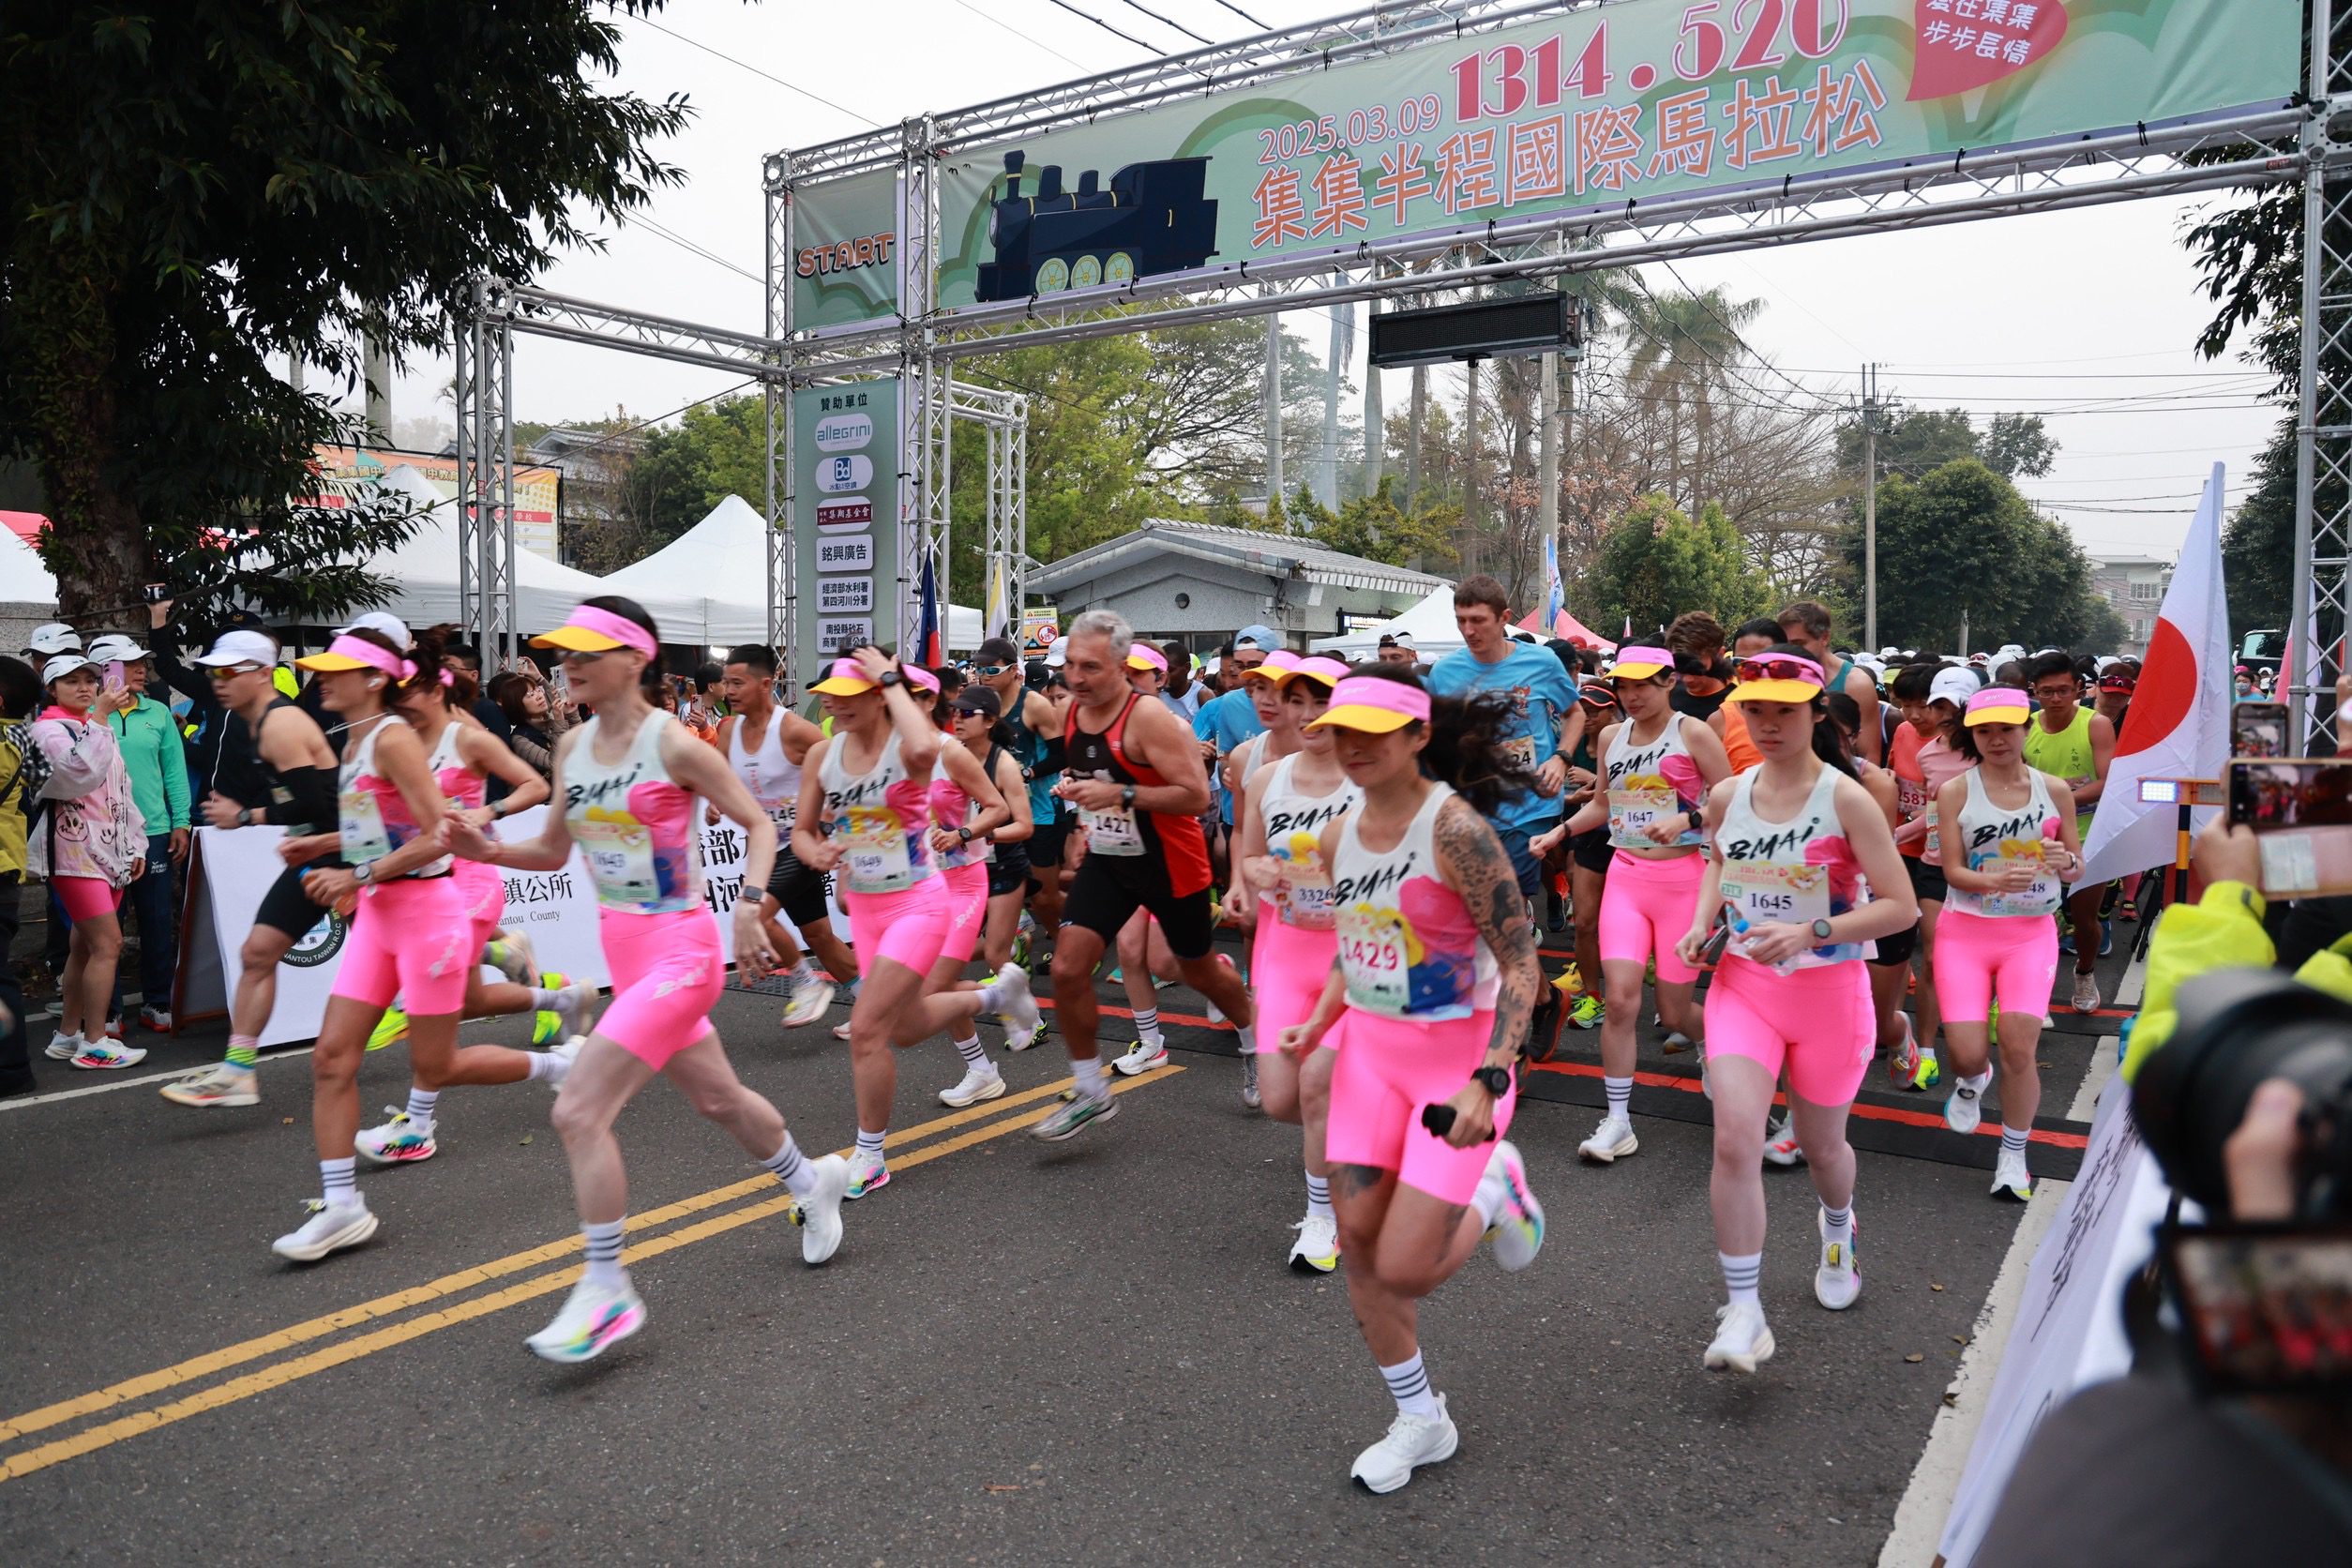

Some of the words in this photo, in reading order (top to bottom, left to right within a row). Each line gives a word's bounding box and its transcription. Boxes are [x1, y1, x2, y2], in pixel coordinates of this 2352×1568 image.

[1922, 20, 2031, 66] 步步長情
[1258, 95, 1442, 165] 2025.03.09
[1250, 58, 1888, 249] 集集半程國際馬拉松
[795, 232, 897, 279] START
[821, 393, 868, 412] 贊助單位
[822, 544, 867, 562] 銘興廣告
[822, 581, 868, 594] 經濟部水利署
[822, 596, 868, 607] 第四河川分署
[826, 624, 864, 634] 南投縣砂石
[1095, 816, 1131, 834] 1427
[1628, 811, 1653, 822] 1647
[1751, 893, 1792, 910] 1645
[498, 915, 524, 926] antou
[530, 911, 561, 921] County
[313, 942, 337, 961] TAIWAN
[1343, 936, 1398, 971] 1429
